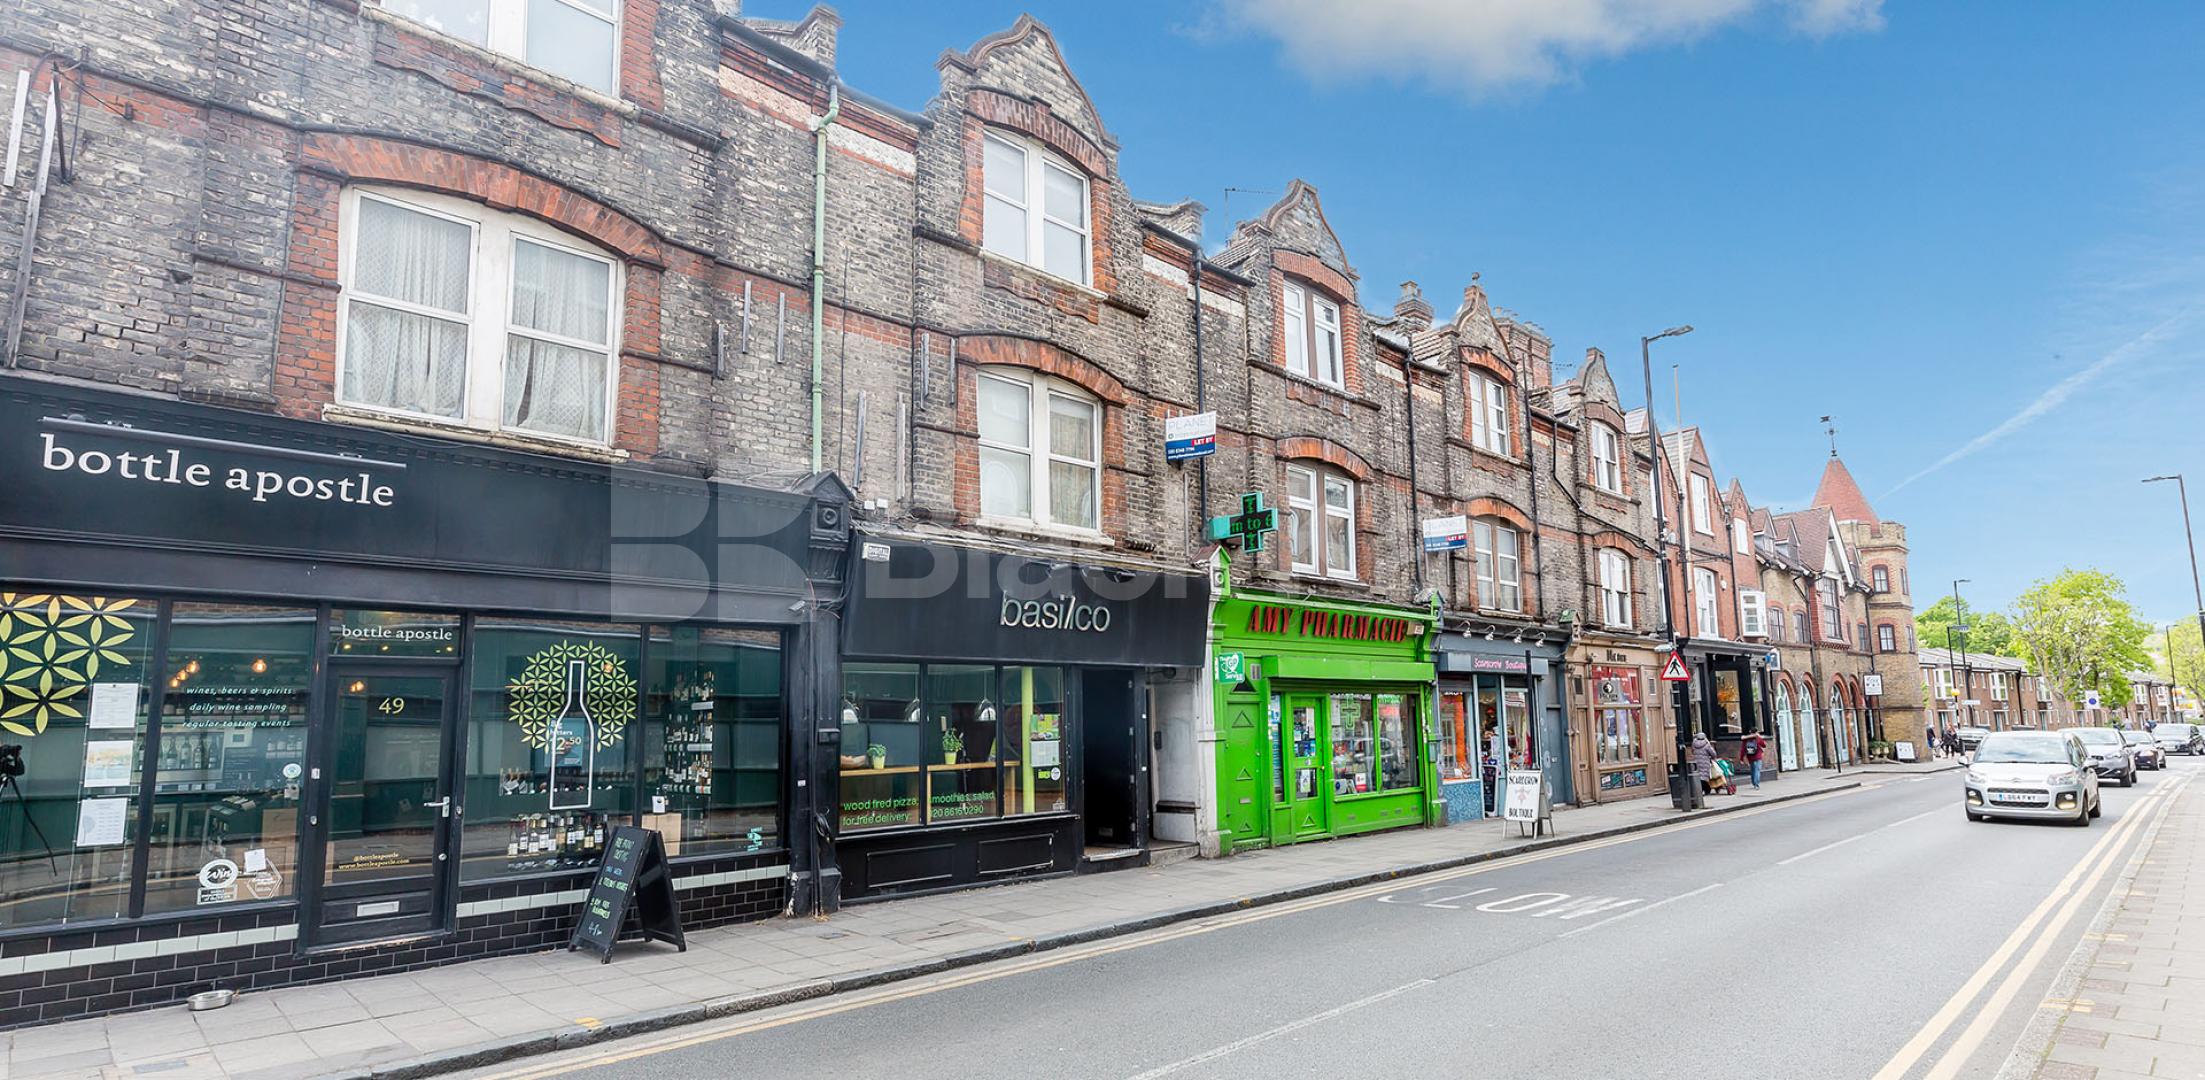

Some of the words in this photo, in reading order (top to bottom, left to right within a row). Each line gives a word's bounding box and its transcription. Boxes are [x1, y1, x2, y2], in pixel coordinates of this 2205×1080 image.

[39, 432, 211, 487] bottle
[225, 463, 394, 507] apostle
[1248, 605, 1293, 634] AMY
[341, 624, 392, 638] bottle
[395, 627, 453, 641] apostle
[221, 686, 247, 695] beers
[262, 686, 292, 696] spirits
[189, 702, 215, 712] daily
[217, 703, 240, 711] wine
[243, 702, 287, 712] sampling
[378, 697, 405, 715] 49
[182, 719, 220, 729] regular
[842, 800, 870, 811] wood
[871, 798, 892, 809] fired
[842, 816, 856, 826] for
[856, 813, 875, 825] free
